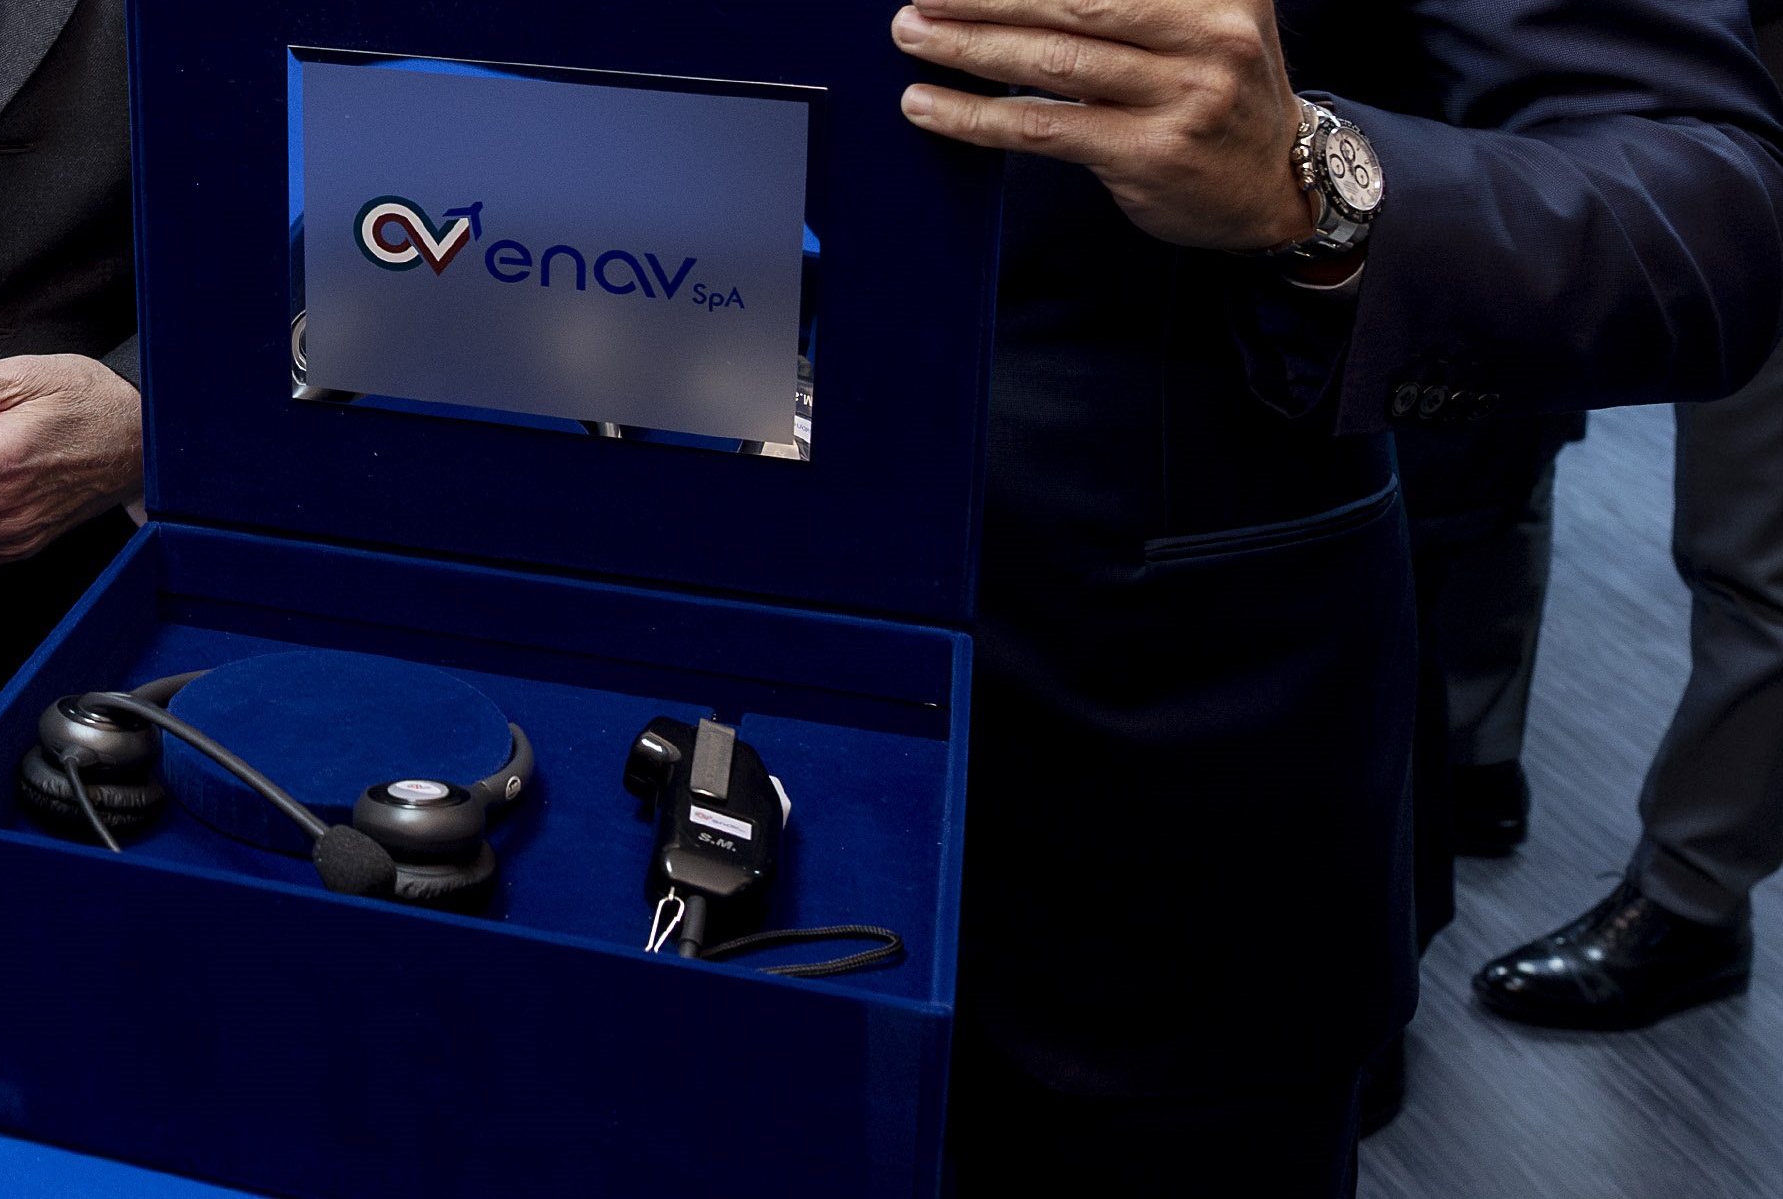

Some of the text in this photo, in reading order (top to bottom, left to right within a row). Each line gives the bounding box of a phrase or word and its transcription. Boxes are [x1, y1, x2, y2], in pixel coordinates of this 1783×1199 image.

[485, 238, 745, 312] enav SpA
[698, 832, 737, 853] S.M.
